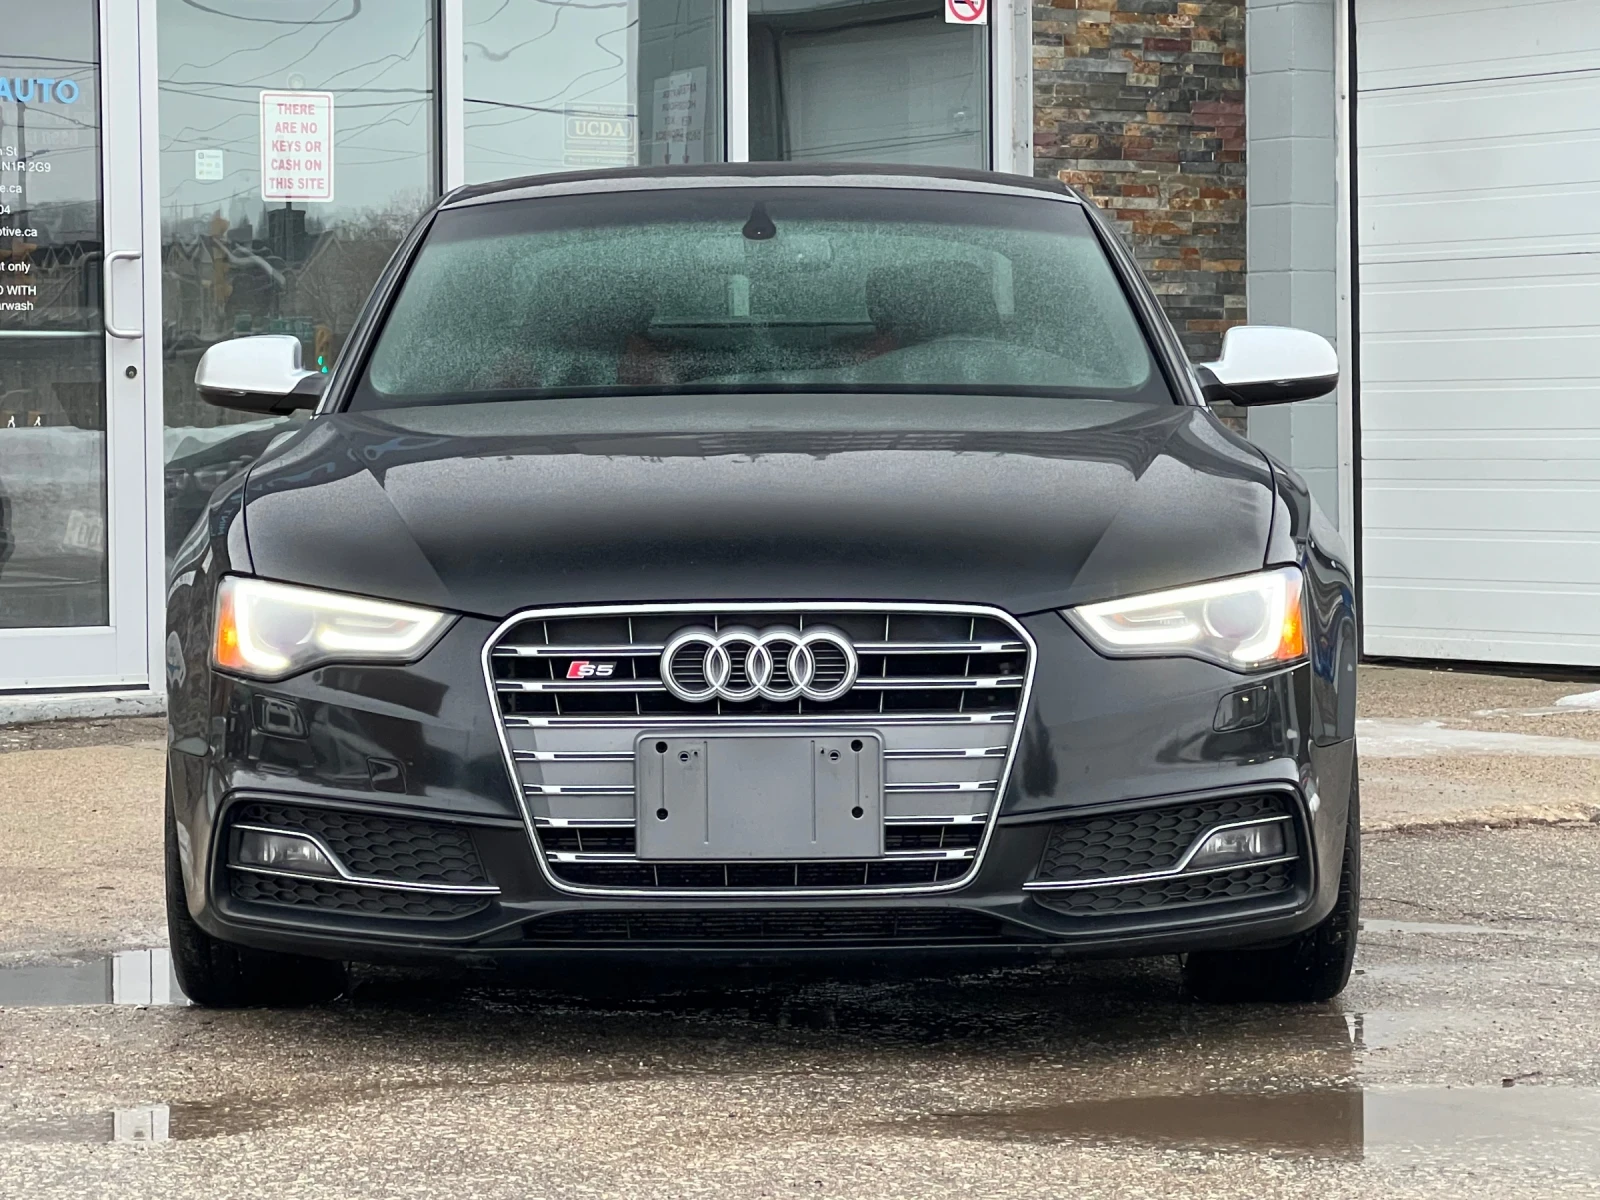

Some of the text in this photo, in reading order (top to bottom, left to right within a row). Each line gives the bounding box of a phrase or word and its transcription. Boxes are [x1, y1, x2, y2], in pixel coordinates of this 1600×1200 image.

[0, 77, 79, 104] AUTO
[277, 104, 315, 115] THERE
[275, 122, 318, 134] ARE NO
[575, 120, 626, 137] UCDA
[272, 140, 321, 152] KEYS OR
[2, 161, 51, 172] N1R 2G9
[271, 159, 322, 171] CASH ON
[269, 178, 324, 190] THIS SITE
[8, 262, 31, 274] only
[7, 286, 36, 295] WITH
[0, 301, 33, 311] rwash
[577, 665, 614, 676] S5
